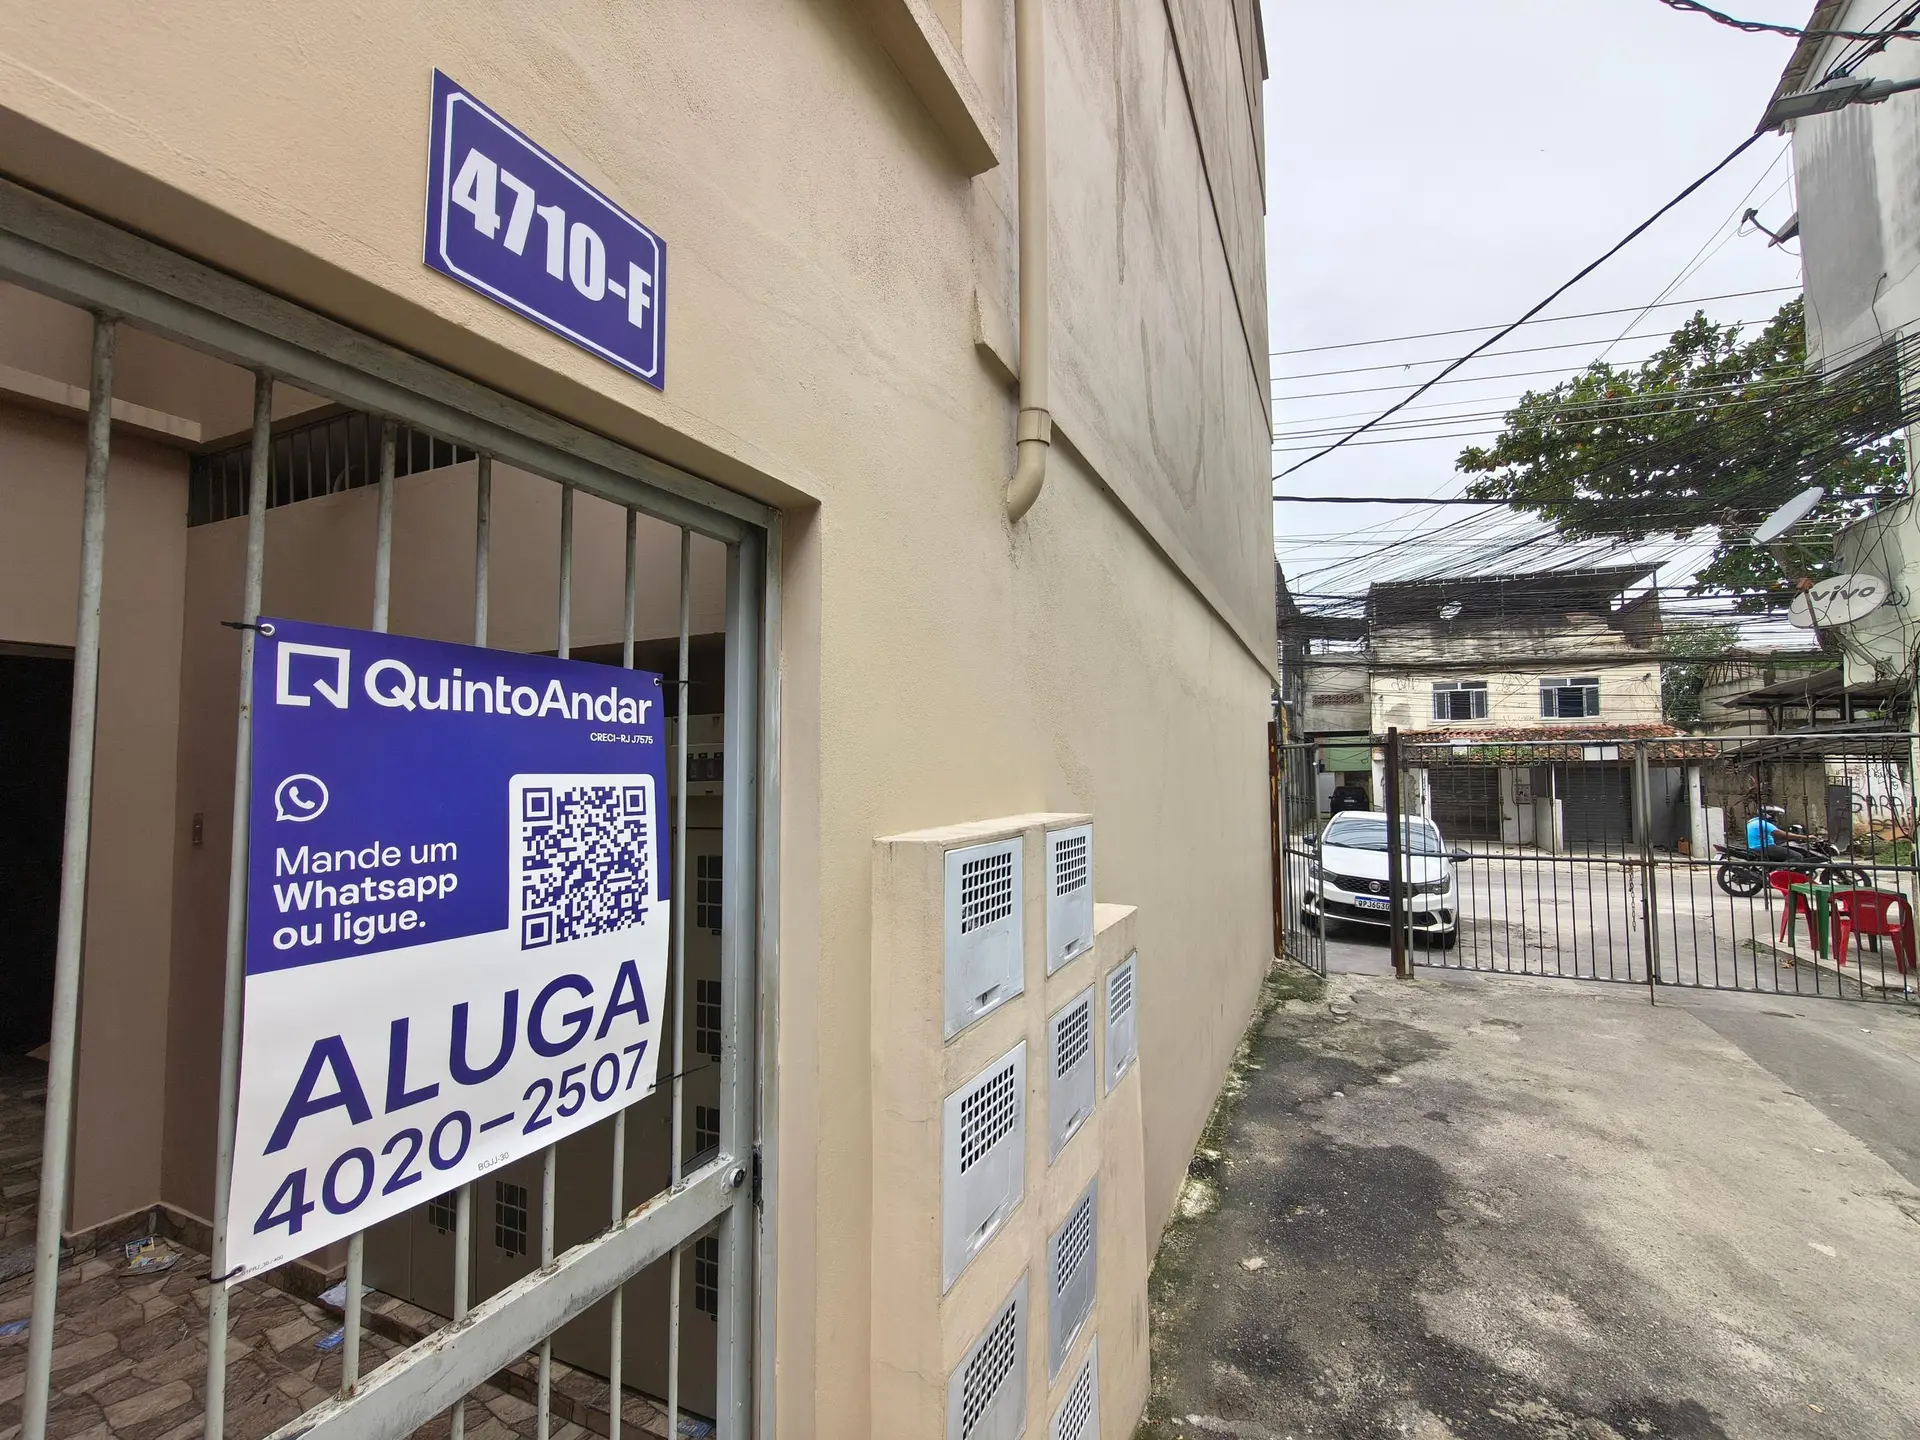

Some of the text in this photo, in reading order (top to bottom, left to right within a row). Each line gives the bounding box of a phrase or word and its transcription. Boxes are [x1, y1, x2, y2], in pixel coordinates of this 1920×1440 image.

[451, 147, 652, 329] 4710-F
[1811, 585, 1876, 601] vivo
[364, 658, 652, 724] QuintoAndar
[590, 732, 631, 743] CRECI-RJ
[275, 841, 457, 877] Mande um
[273, 871, 458, 912] Whatsapp
[273, 910, 426, 950] ou ligue.
[262, 959, 650, 1156] ALUGA
[253, 1040, 648, 1236] 4020-2507
